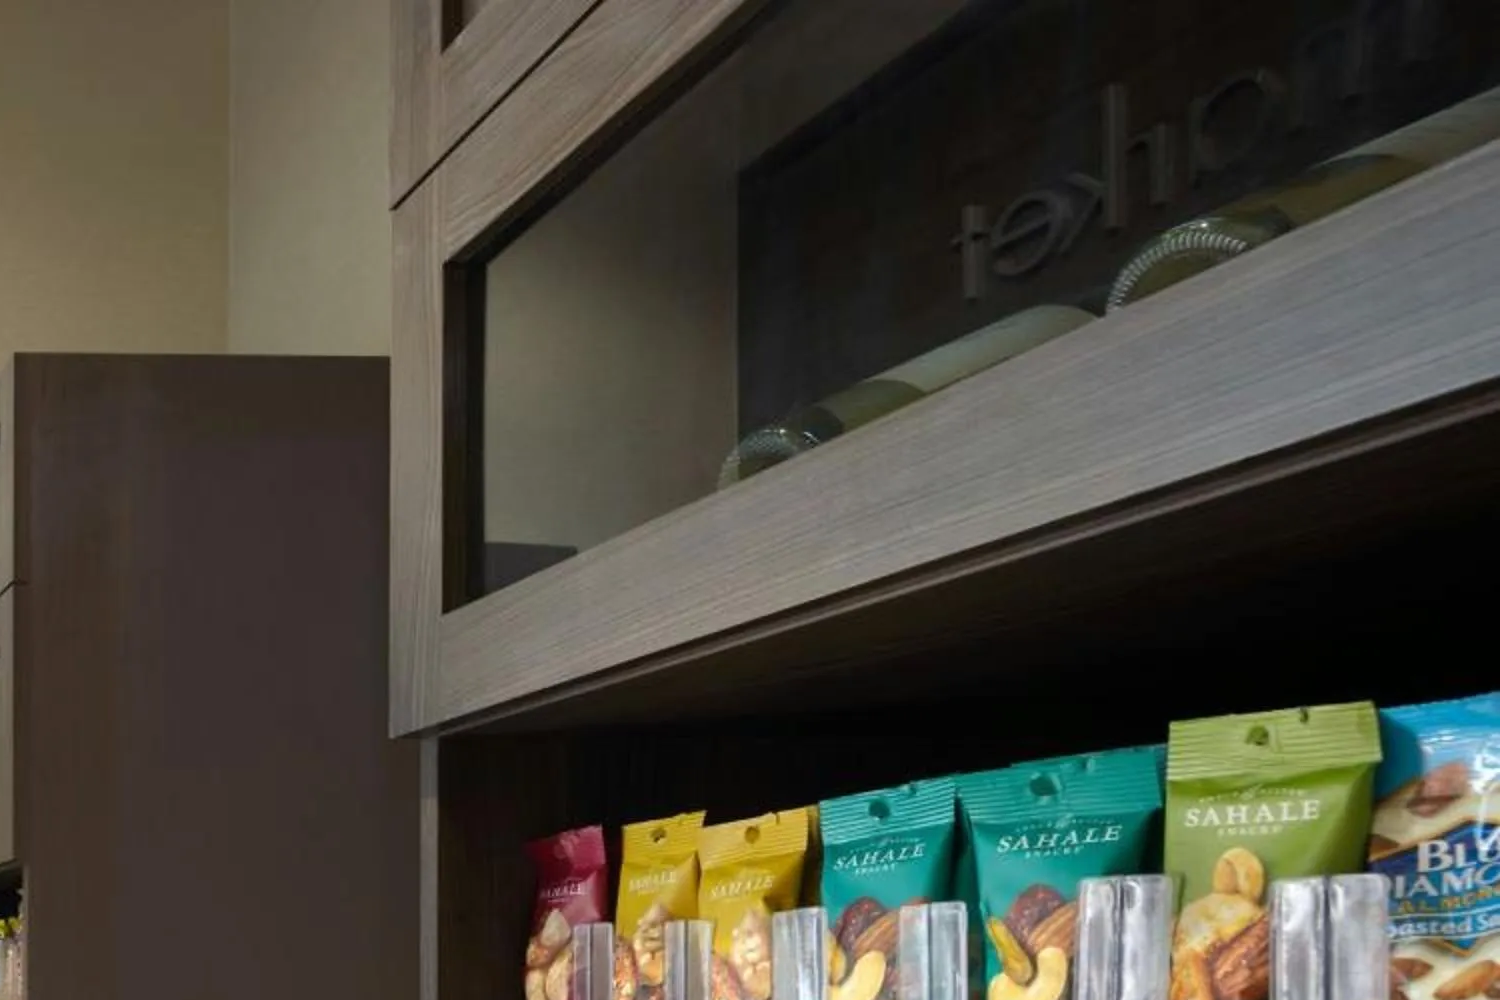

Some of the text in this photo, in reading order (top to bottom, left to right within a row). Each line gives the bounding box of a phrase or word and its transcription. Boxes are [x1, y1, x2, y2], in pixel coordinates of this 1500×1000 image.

[1183, 799, 1322, 828] SAHALE
[996, 824, 1123, 854] SAHALE
[833, 842, 926, 871] SAHALE
